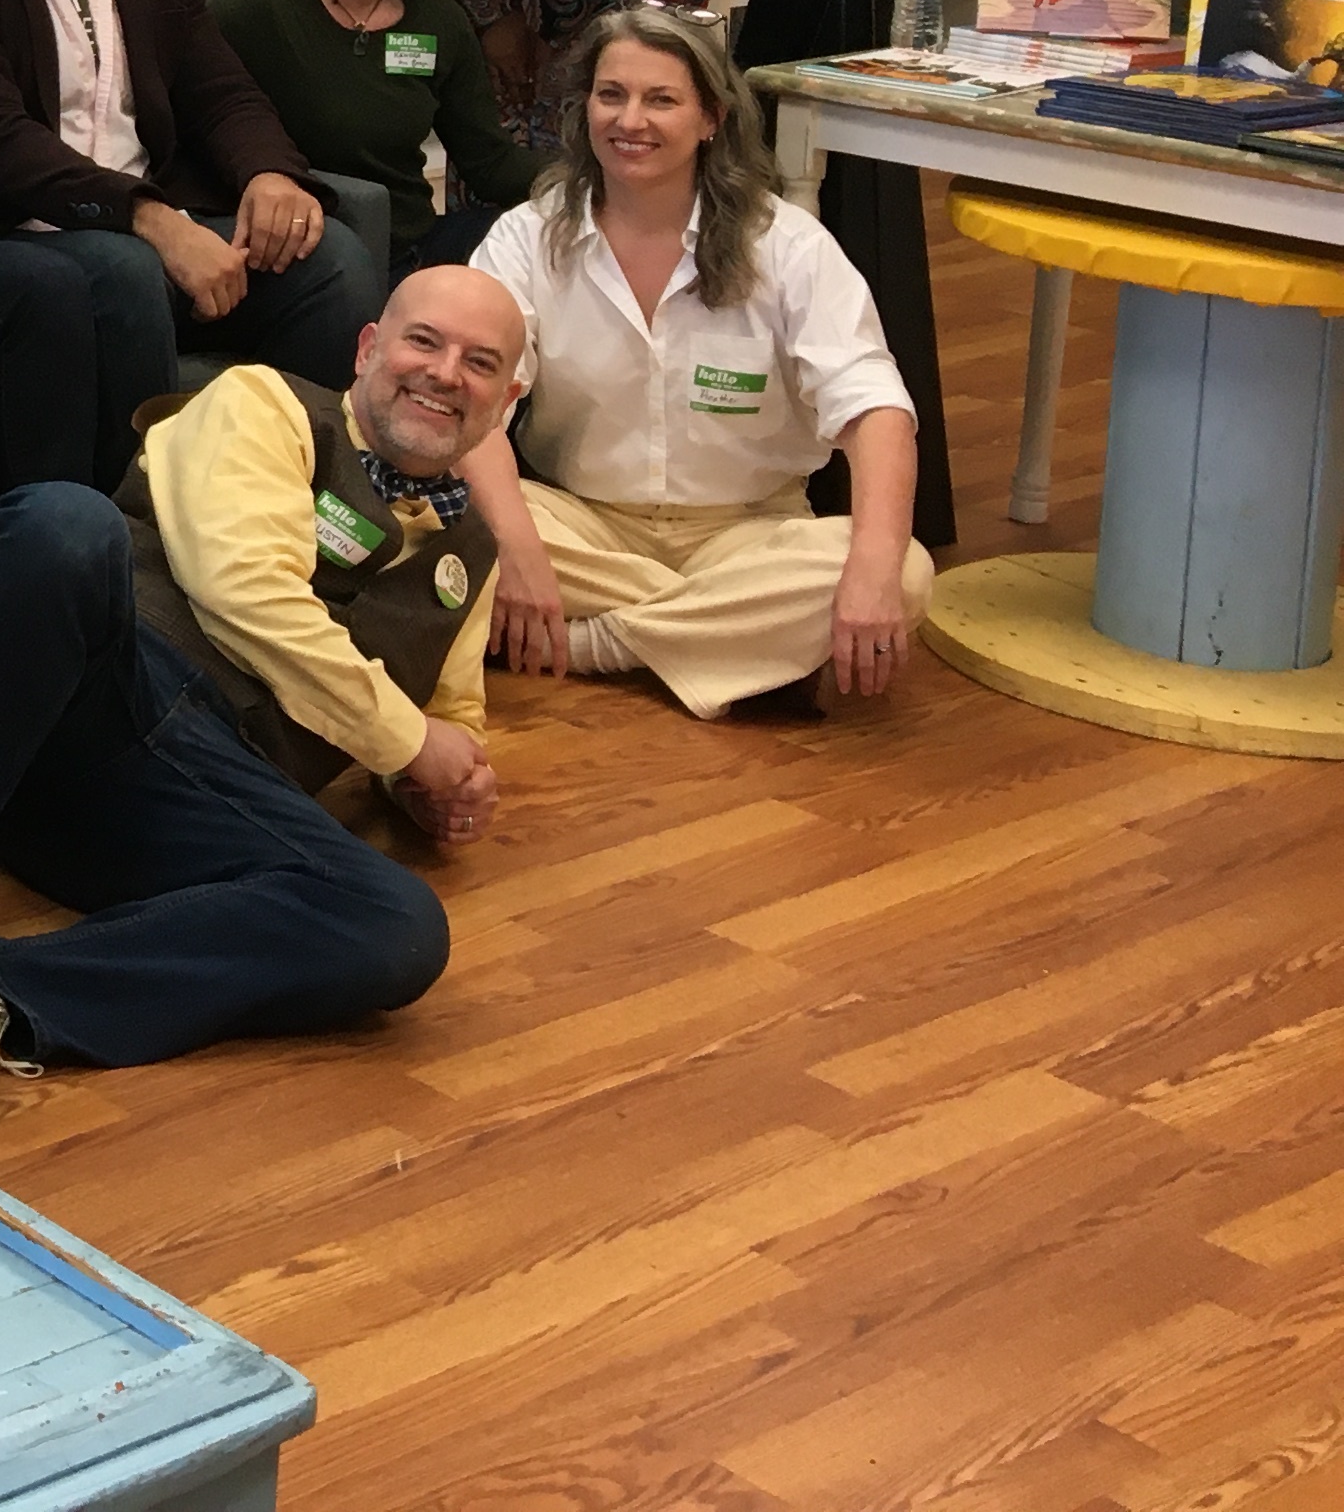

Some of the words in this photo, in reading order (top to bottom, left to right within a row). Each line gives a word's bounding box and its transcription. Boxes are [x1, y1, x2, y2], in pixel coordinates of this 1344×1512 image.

[388, 34, 419, 46] hello
[696, 367, 738, 386] hello
[318, 494, 357, 528] hello
